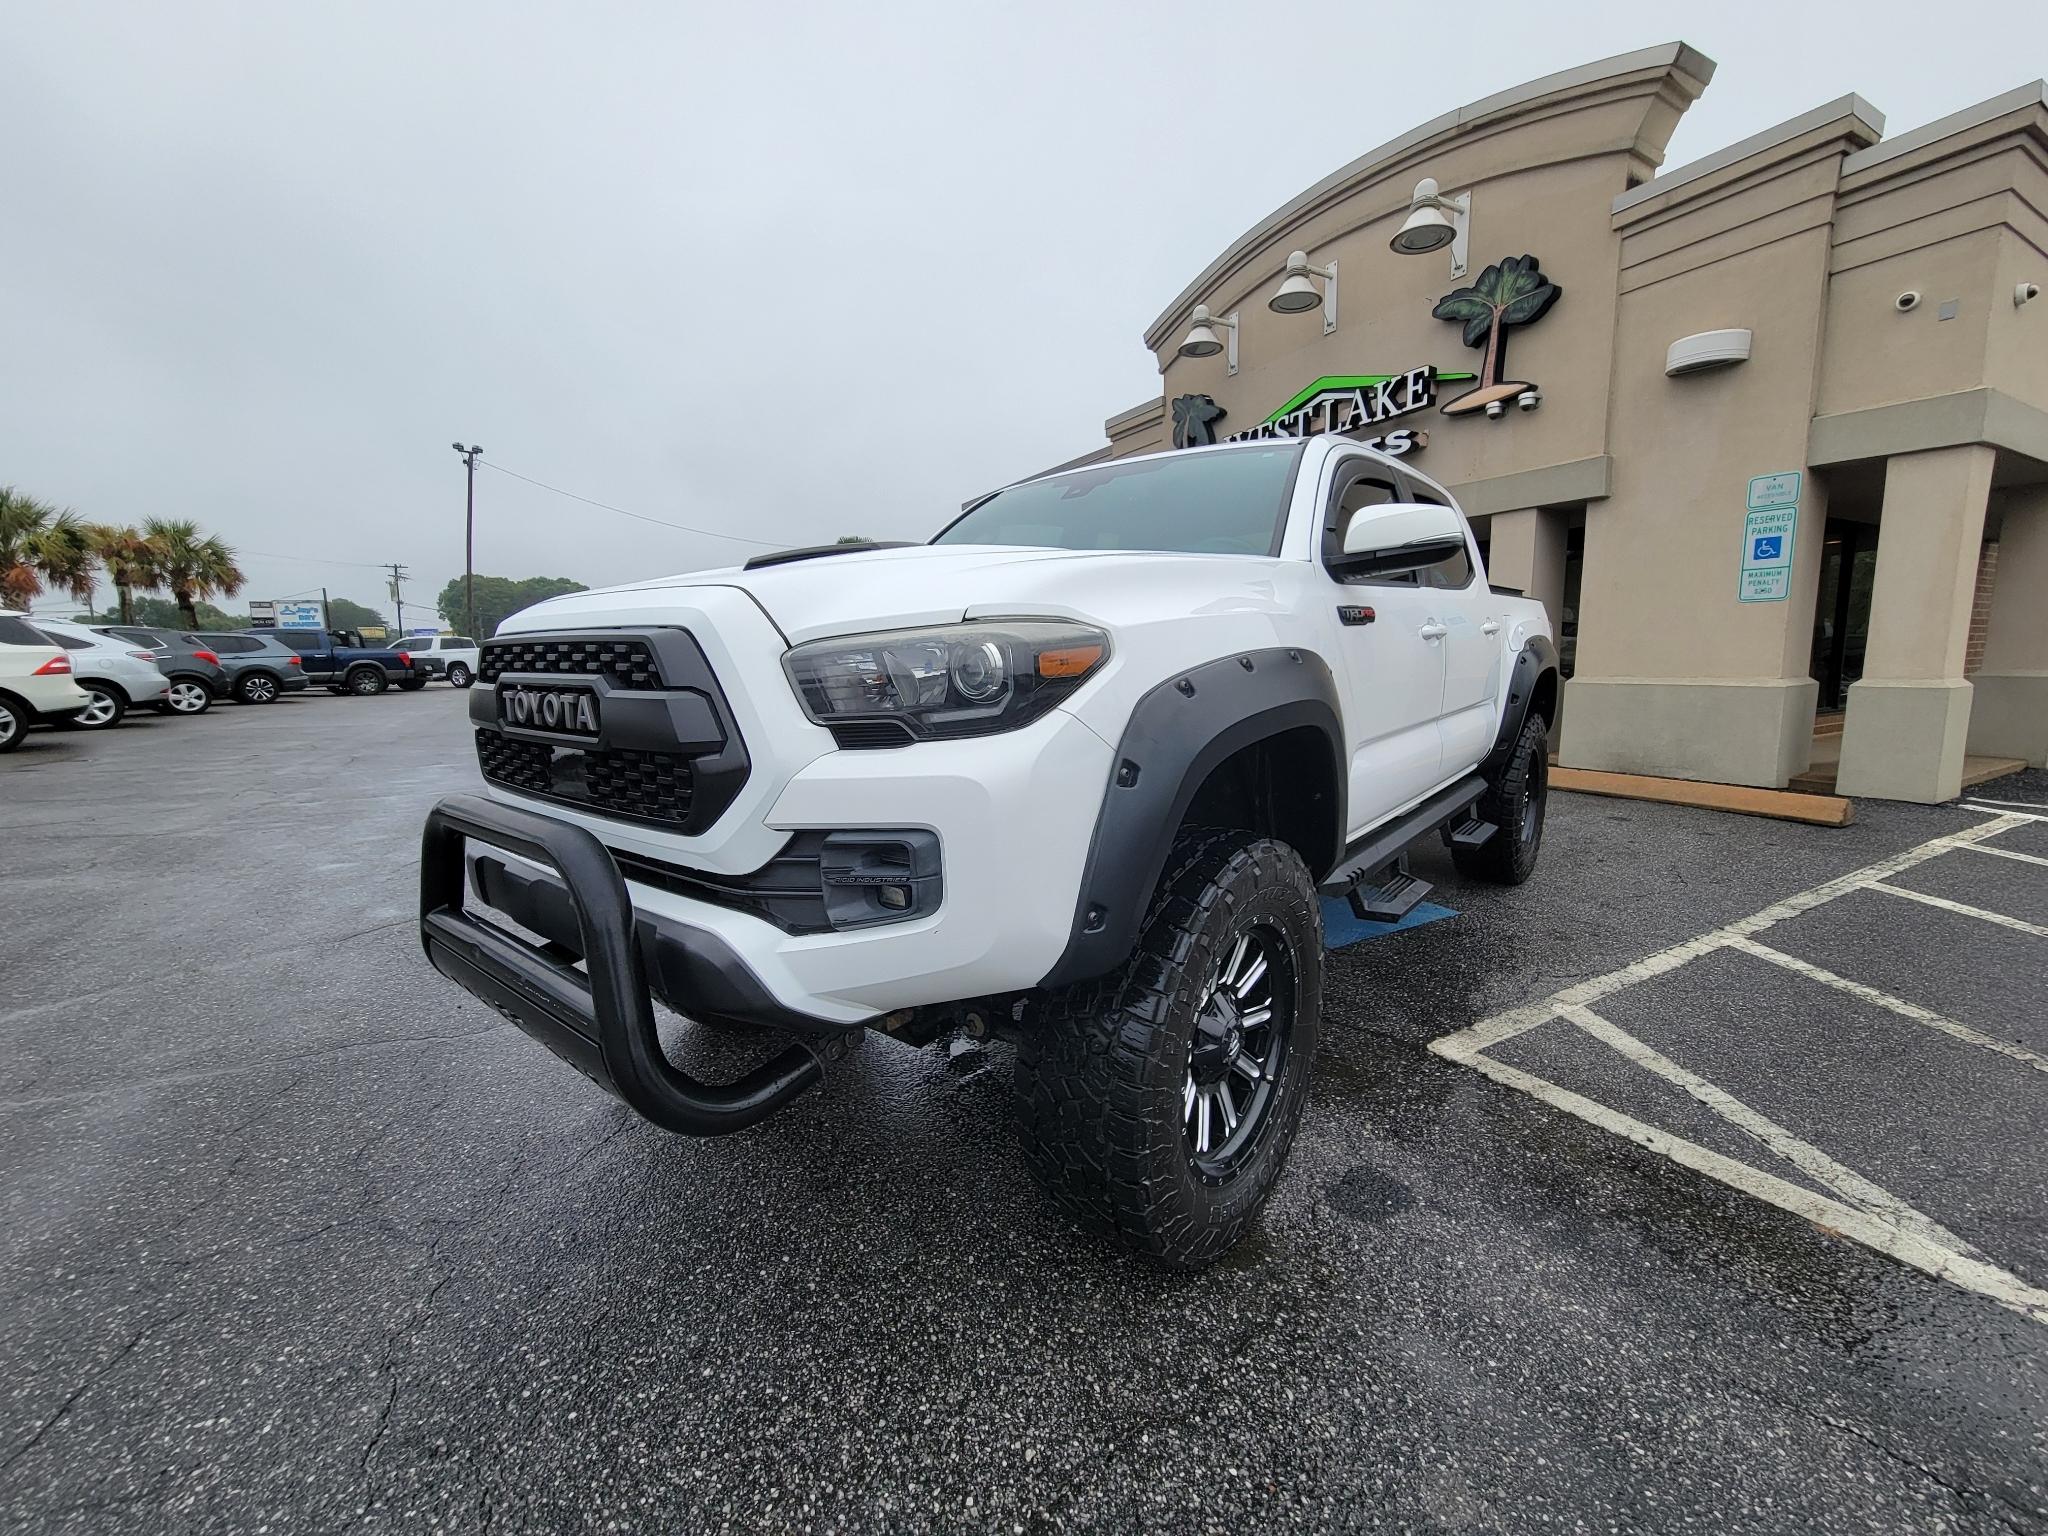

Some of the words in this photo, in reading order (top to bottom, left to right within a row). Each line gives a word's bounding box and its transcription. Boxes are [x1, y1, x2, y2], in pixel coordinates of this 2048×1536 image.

[1321, 364, 1431, 435] LAKE
[1766, 483, 1784, 491] VAN
[1748, 513, 1793, 525] RESERVED
[1751, 525, 1788, 535] PARKING
[1748, 570, 1782, 578] MAXIMUM
[503, 690, 598, 731] TOYOTA
